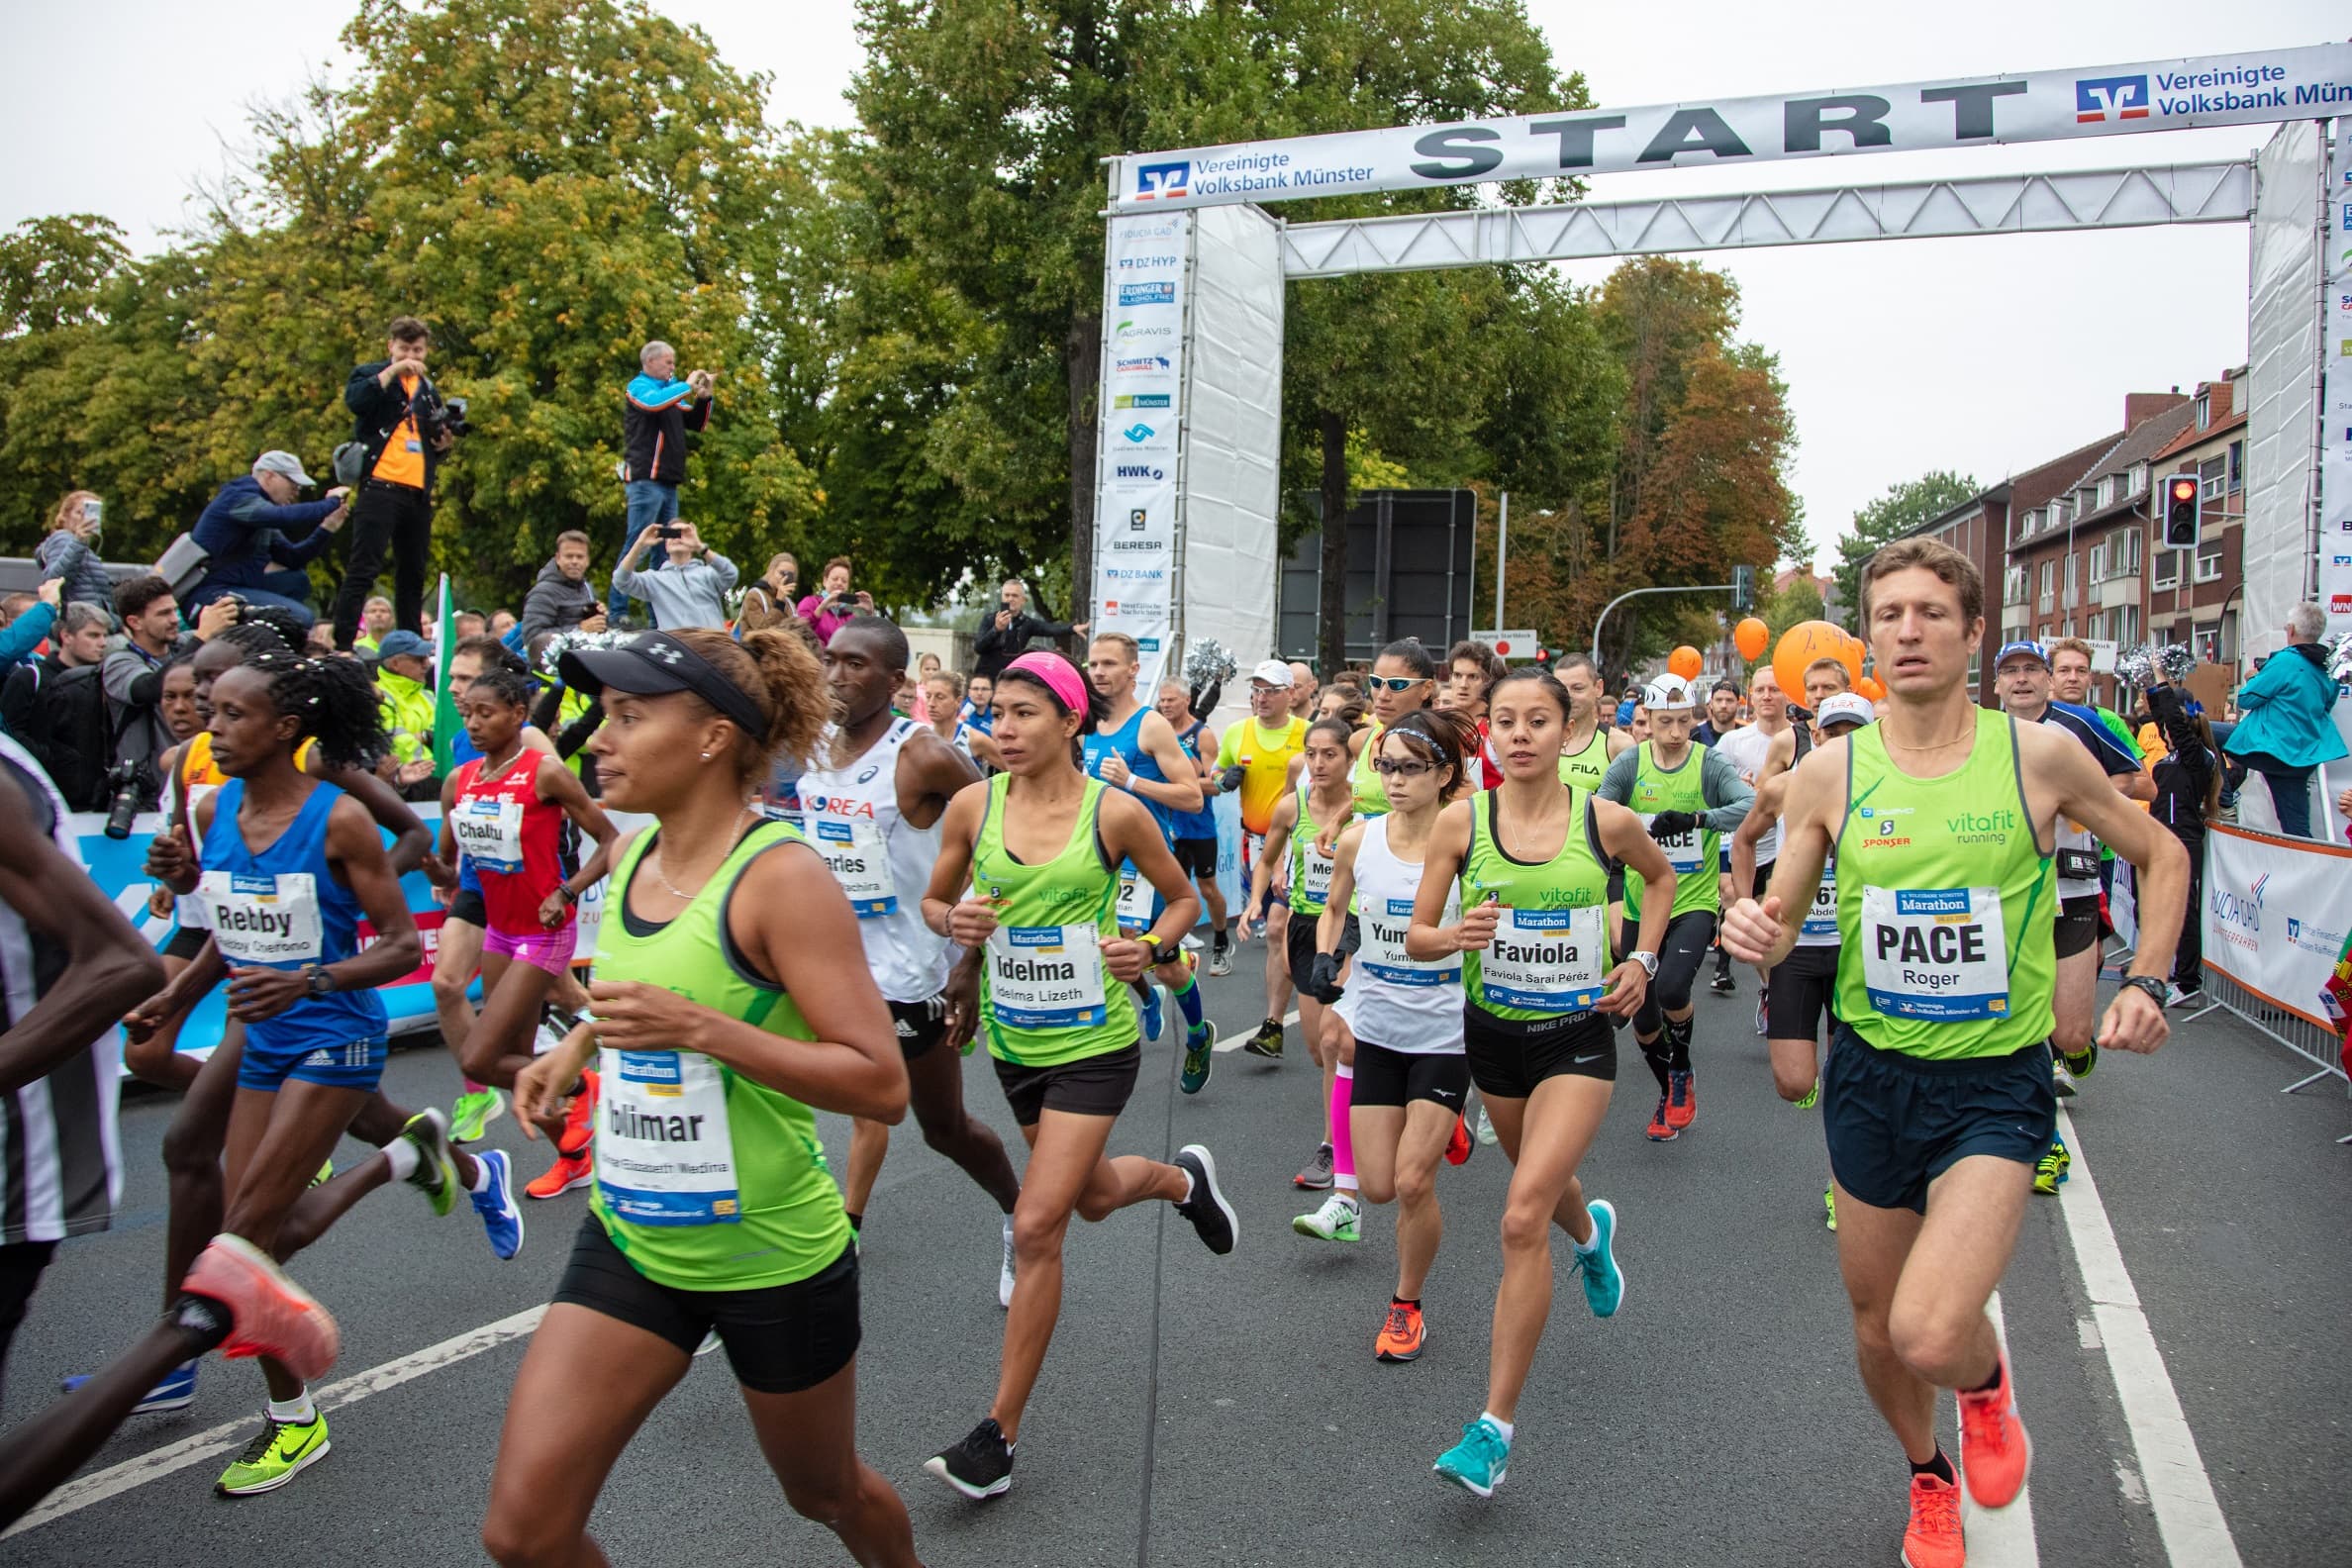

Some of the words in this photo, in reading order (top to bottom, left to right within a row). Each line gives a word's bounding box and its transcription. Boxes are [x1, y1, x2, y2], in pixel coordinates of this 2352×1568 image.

[2156, 64, 2285, 91] Vereinigte
[2158, 86, 2287, 116] Volksbank
[1409, 80, 2027, 179] START
[1196, 152, 1290, 176] Vereinigte
[1194, 172, 1288, 196] Volksbank
[1293, 166, 1375, 186] Münster
[1151, 256, 1177, 267] HYP
[1122, 327, 1172, 338] AGRAVIS
[1117, 357, 1153, 367] SCHMITZ
[1117, 466, 1150, 477] HWK
[1121, 569, 1133, 579] DZ
[1135, 569, 1163, 579] BANK
[2333, 603, 2351, 613] WN
[1571, 763, 1601, 775] FILA
[804, 795, 875, 820] KOREA
[1947, 810, 2015, 833] vitafit
[459, 822, 503, 840] Chaltu
[1957, 833, 2007, 845] running
[1862, 837, 1911, 848] SPONSER
[1539, 888, 1592, 903] vitafit
[1901, 899, 1966, 911] Marathon
[1518, 917, 1566, 927] Marathon
[1012, 934, 1060, 944] Marathon
[1876, 924, 1987, 964] PACE
[1493, 939, 1579, 964] Faviola
[997, 955, 1076, 982] Idelma
[1484, 967, 1522, 983] Faviola
[1525, 974, 1555, 984] Sarai
[1903, 969, 1961, 989] Roger
[996, 985, 1034, 1002] Idelma
[1038, 988, 1084, 1002] Lizeth
[1526, 1021, 1558, 1033] NIKE
[1559, 1013, 1587, 1028] PRO
